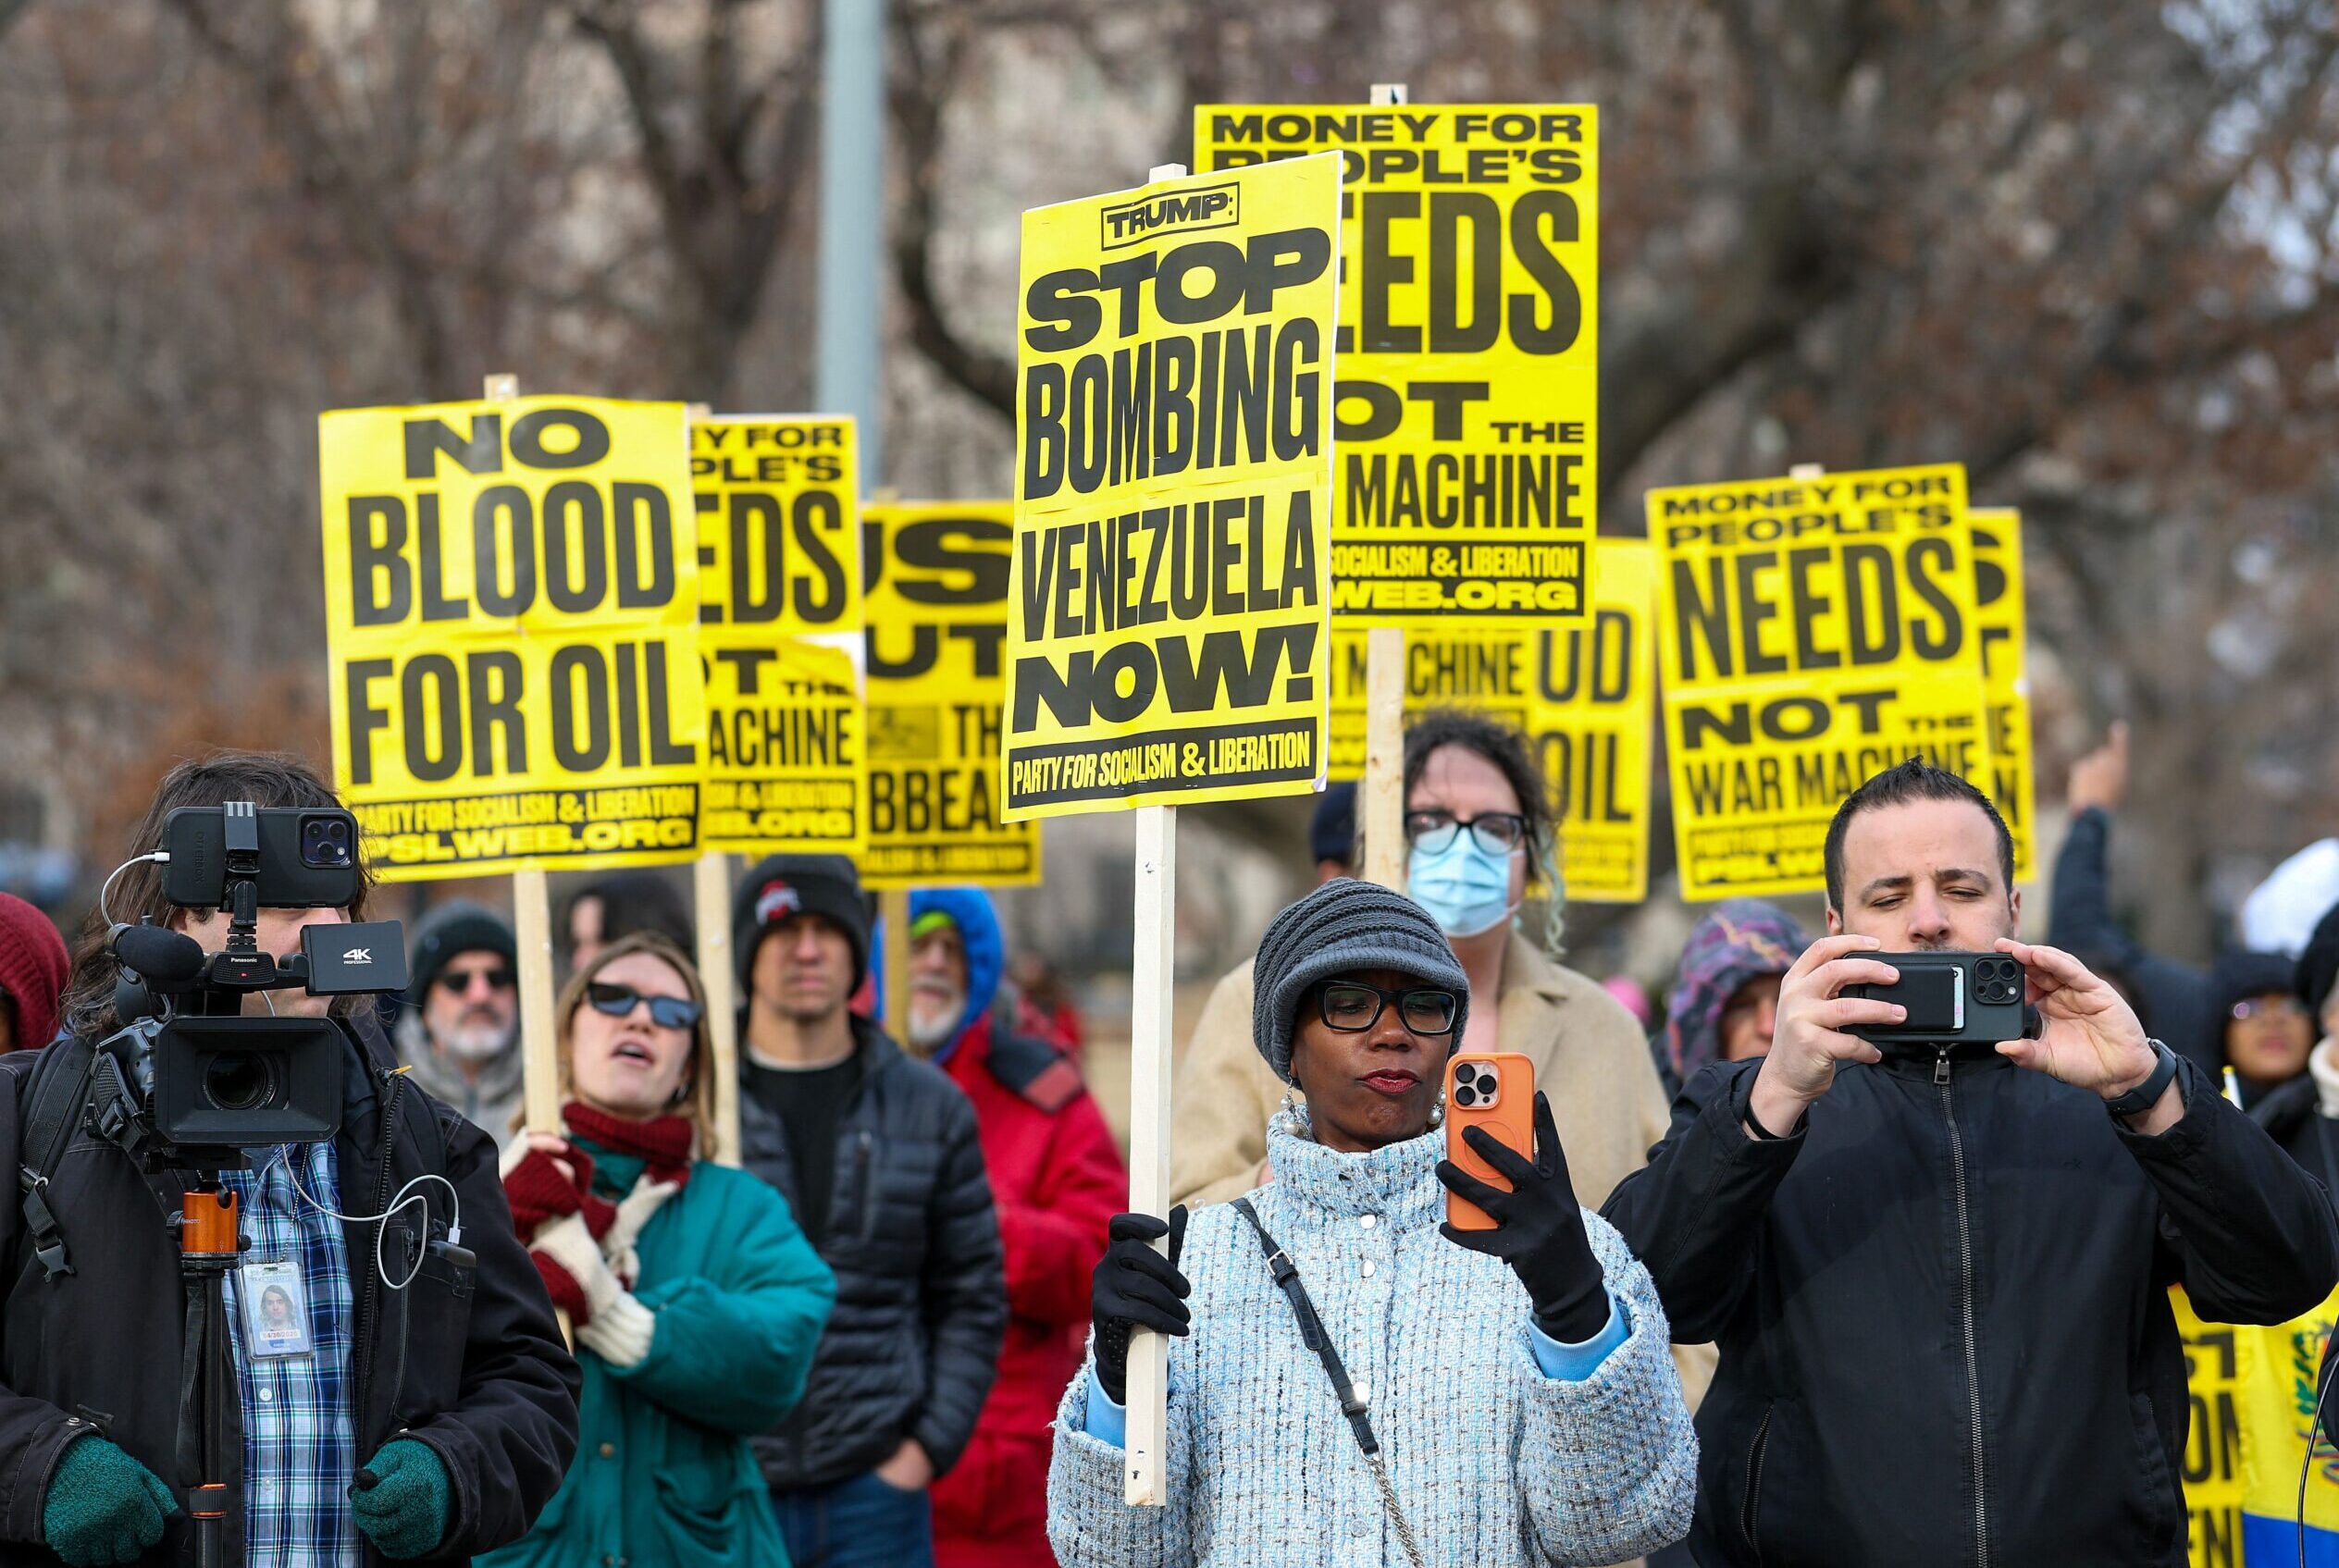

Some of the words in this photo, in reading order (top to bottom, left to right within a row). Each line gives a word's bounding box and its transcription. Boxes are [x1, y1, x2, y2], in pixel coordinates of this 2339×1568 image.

[1211, 114, 1441, 144] MONEY
[1454, 113, 1583, 144] FOR
[1107, 191, 1234, 239] TRUMP:
[1024, 227, 1331, 352] STOP
[1334, 190, 1582, 356] EDS
[746, 426, 842, 449] FOR
[1023, 317, 1320, 500] BOMBING
[1333, 379, 1490, 442] OT
[1489, 421, 1584, 444] THE
[402, 408, 612, 480] NO
[1346, 452, 1584, 529] MACHINE
[1665, 485, 1836, 516] MONEY
[1853, 476, 1950, 502] FOR
[346, 480, 677, 628] BLOOD
[1667, 503, 1953, 549] PEOPLE'S
[1021, 490, 1318, 642] VENEZUELA
[1430, 546, 1458, 578] &
[1460, 546, 1578, 578] LIBERATION
[1330, 579, 1578, 611] WEB.ORG
[1671, 537, 1963, 682] NEEDS
[865, 623, 1008, 681] UT
[1011, 622, 1319, 735] NOW!
[1347, 641, 1525, 698] MCHINE
[345, 648, 529, 785] FOR
[549, 638, 697, 772] OIL
[710, 708, 853, 767] ACHINE
[952, 705, 1001, 758] TH
[1679, 689, 1898, 750] NOT
[1012, 754, 1063, 796] PARTY
[1062, 752, 1098, 790] FOR
[1097, 741, 1177, 787] SOCIALISM
[1180, 741, 1207, 778] &
[1208, 730, 1310, 777] LIBERATION
[1684, 756, 1785, 817] WAR
[414, 800, 454, 831] FOR
[454, 791, 555, 829] SOCIALISM
[557, 792, 585, 822] &
[585, 784, 696, 821] LIBERATION
[342, 948, 373, 960] 4K
